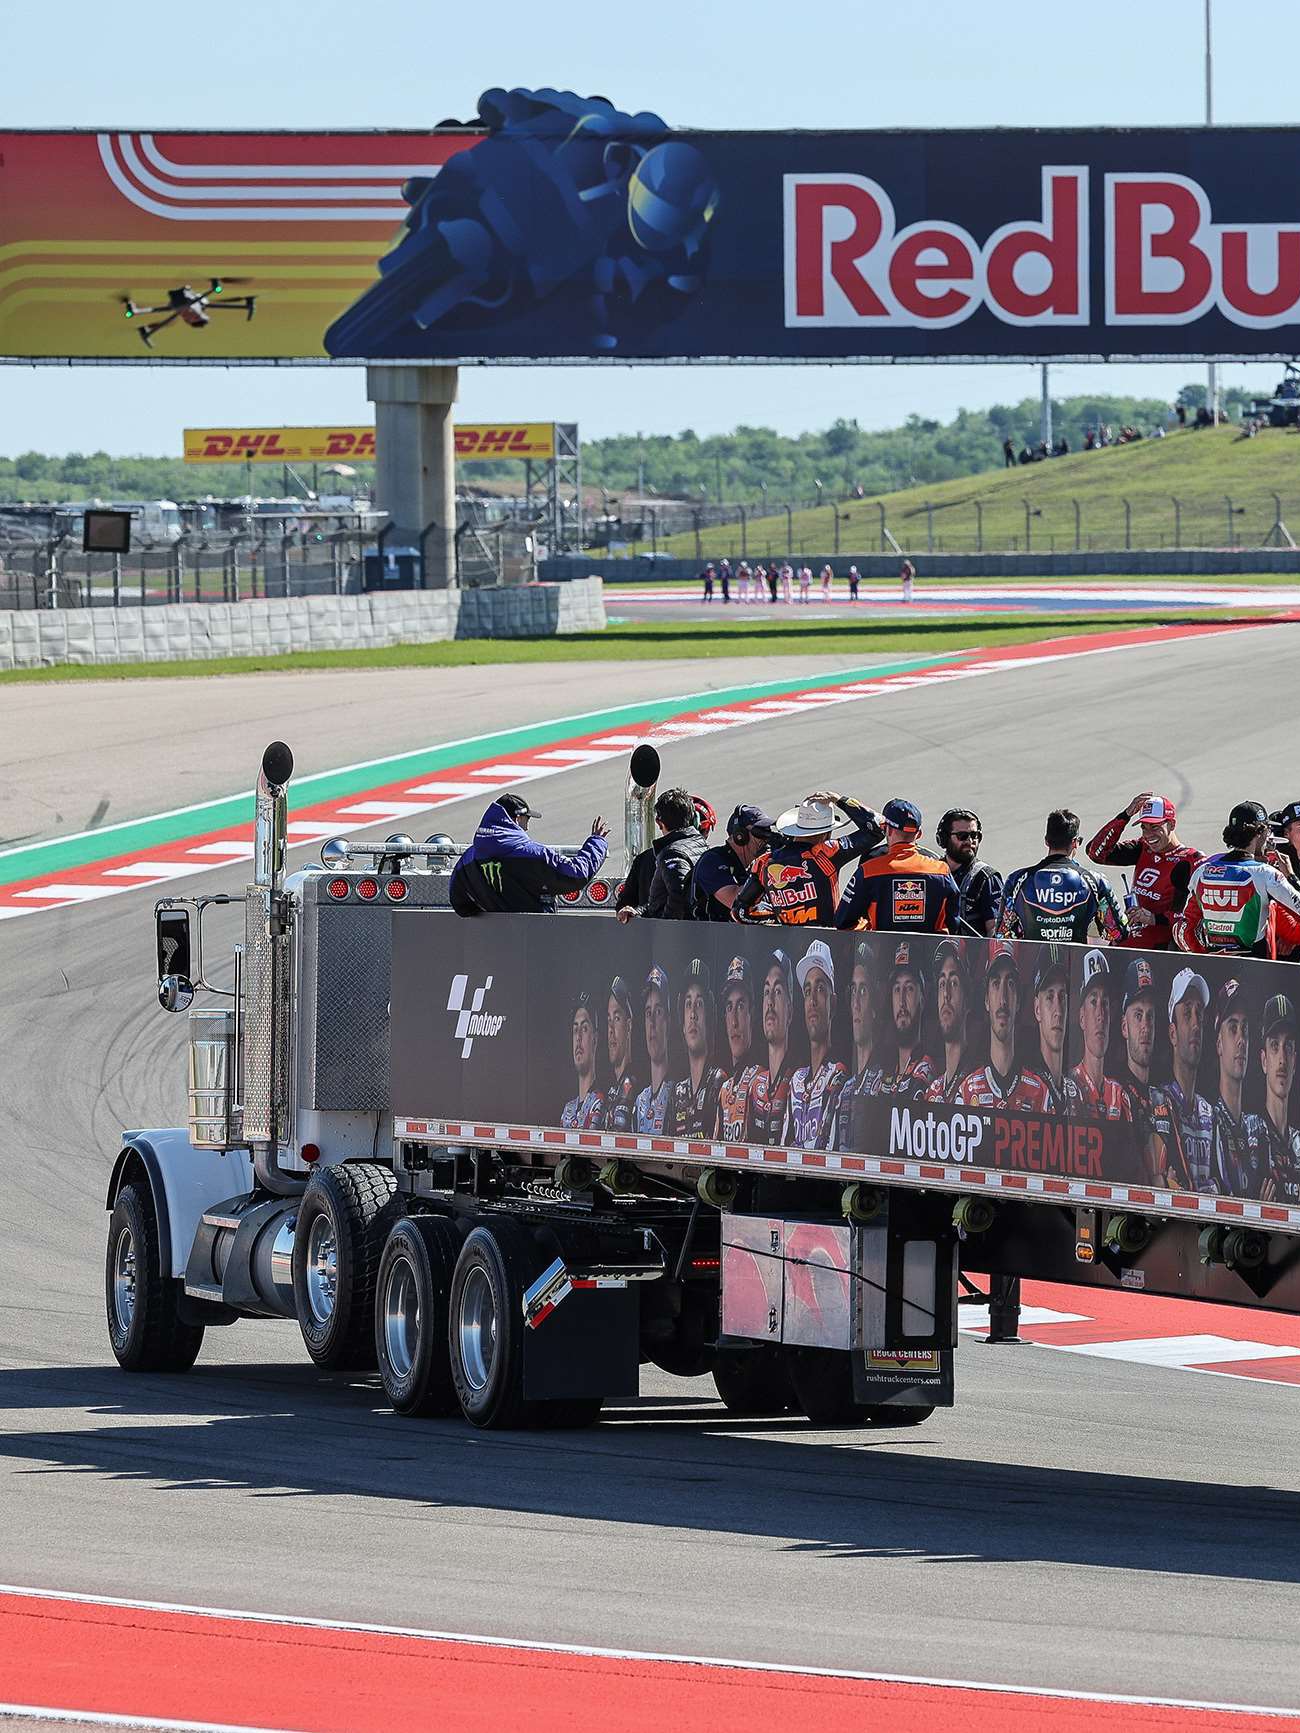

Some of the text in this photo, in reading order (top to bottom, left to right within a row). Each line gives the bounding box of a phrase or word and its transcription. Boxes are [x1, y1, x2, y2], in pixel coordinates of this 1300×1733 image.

[783, 165, 1089, 328] Red
[204, 434, 285, 456] DHL
[326, 433, 376, 455] DH
[784, 881, 818, 906] Bull
[1035, 888, 1078, 907] Wispr
[1040, 926, 1073, 941] aprilia
[1212, 923, 1233, 932] Castrol
[993, 1116, 1103, 1177] PREMIER
[872, 1350, 932, 1359] TRUCK CENTERS
[866, 1375, 941, 1385] rushtruckcenters.com
